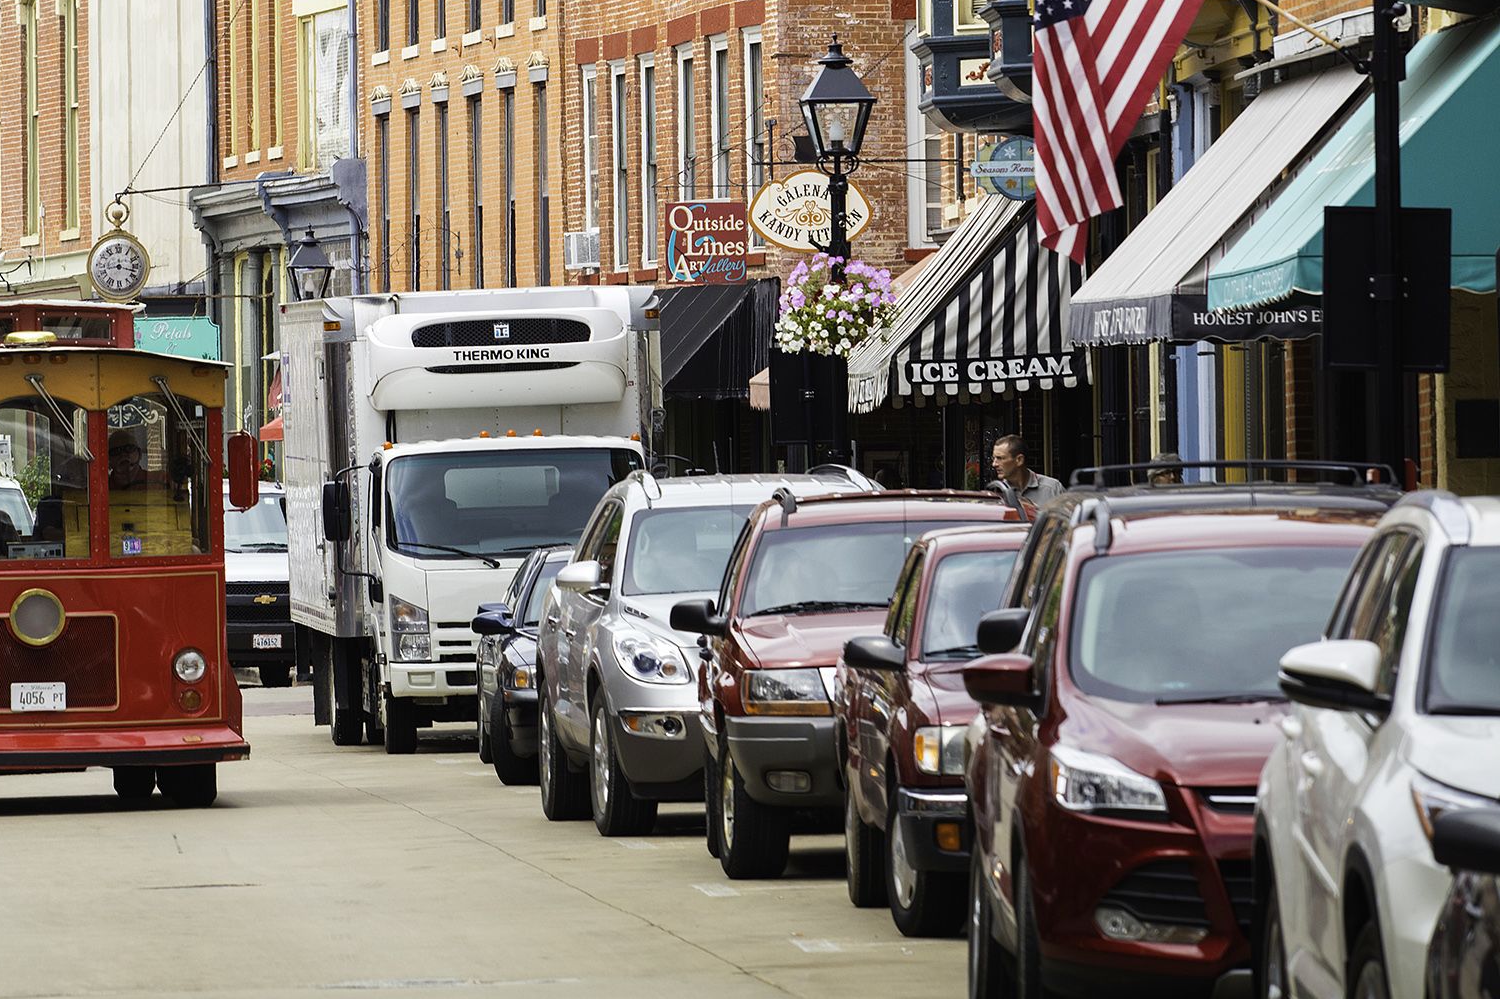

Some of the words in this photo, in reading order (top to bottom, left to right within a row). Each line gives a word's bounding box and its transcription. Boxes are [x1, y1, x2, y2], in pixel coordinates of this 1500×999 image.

[776, 183, 831, 207] GALENA
[669, 205, 745, 232] Outside
[758, 209, 802, 243] KANDY
[806, 208, 864, 243] KITEN
[685, 230, 745, 257] Lines
[1193, 312, 1254, 326] HONEST
[1256, 310, 1308, 325] JOHN'S
[150, 320, 192, 341] Petals
[453, 349, 514, 361] THERMO
[516, 348, 550, 359] KING
[911, 361, 959, 382] ICE
[967, 355, 1073, 380] CREAM
[19, 691, 45, 705] 4056
[53, 692, 64, 702] PT
